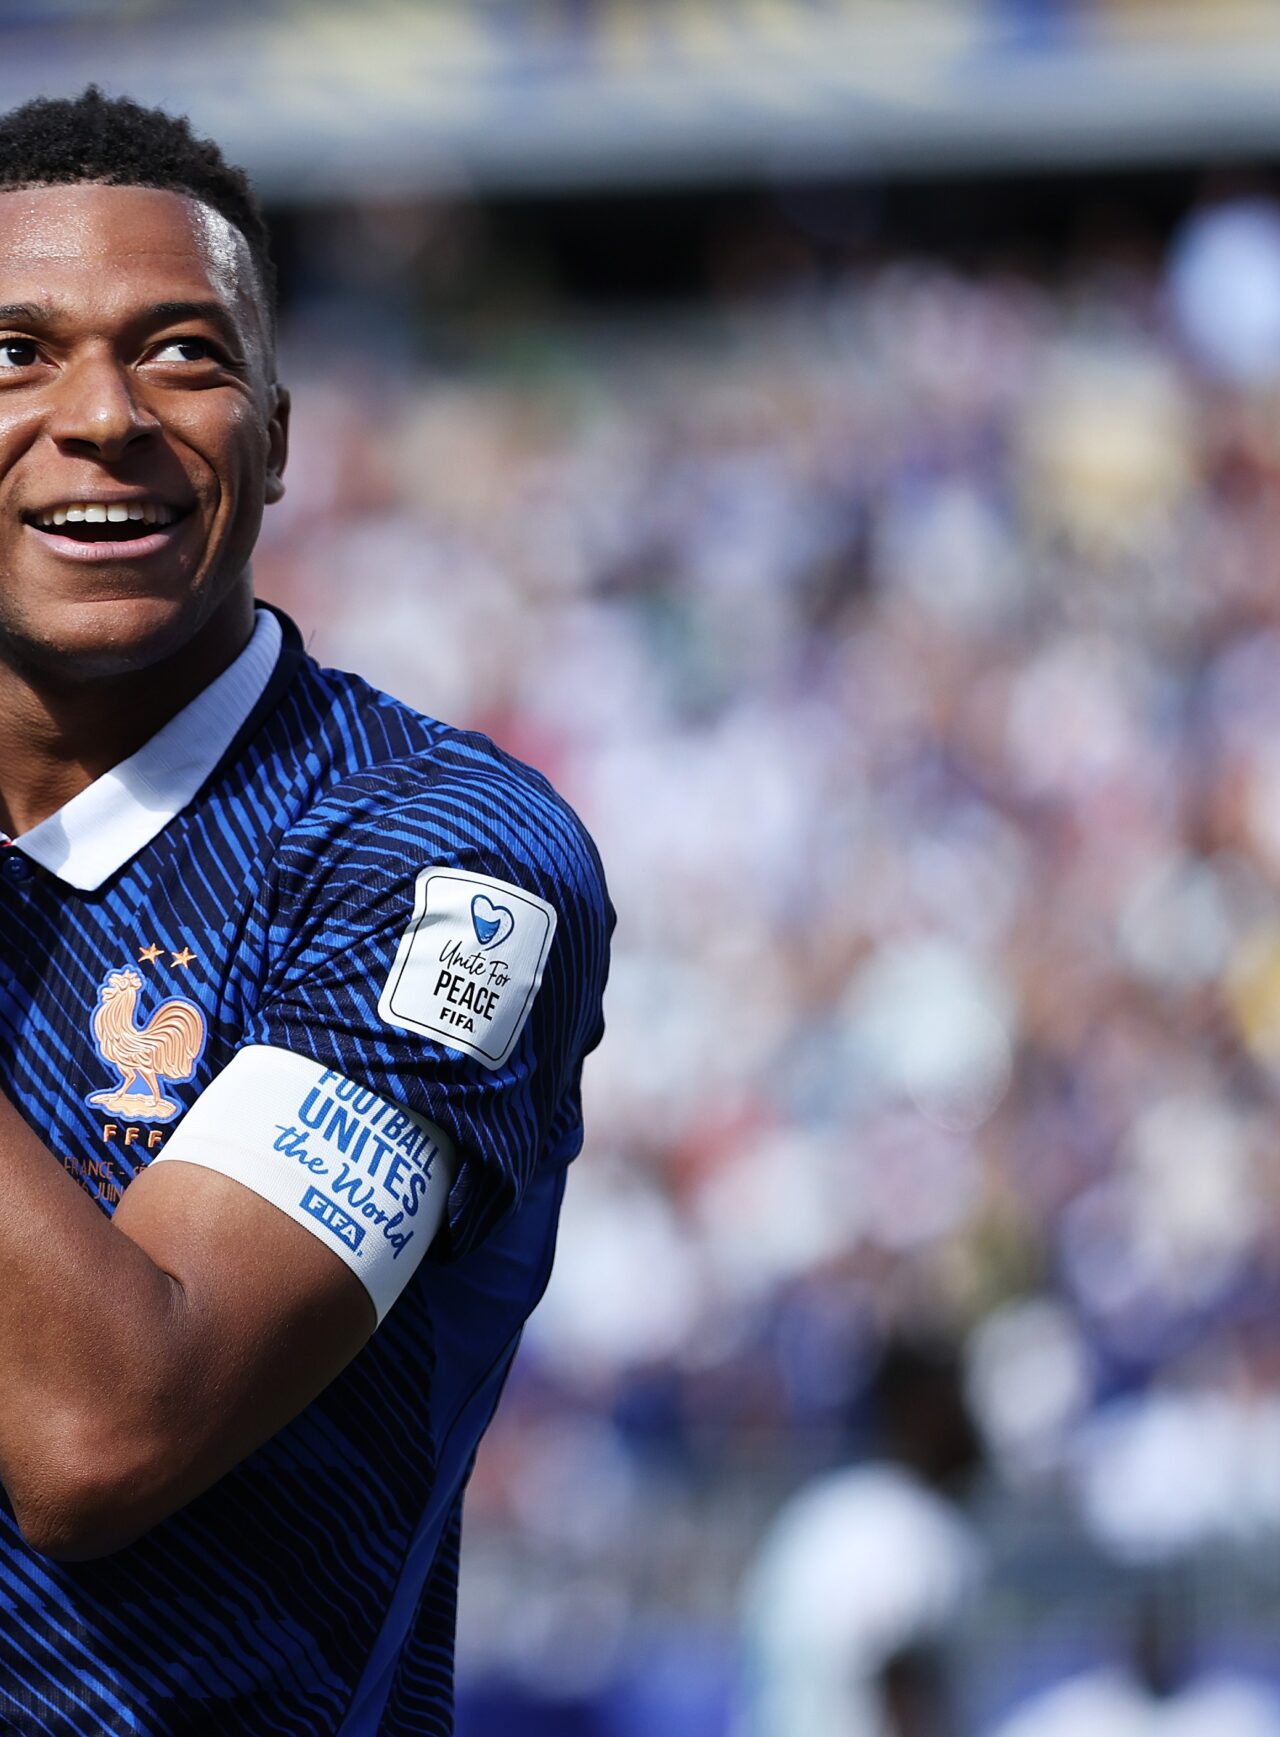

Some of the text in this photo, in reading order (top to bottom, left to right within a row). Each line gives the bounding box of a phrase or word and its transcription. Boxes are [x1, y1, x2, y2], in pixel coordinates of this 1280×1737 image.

[439, 940, 511, 987] Unite For
[433, 969, 500, 1021] PEACE
[439, 1007, 474, 1033] FIFA
[318, 1069, 439, 1180] FOOTBALL
[64, 1156, 114, 1179] FRANCE
[298, 1087, 426, 1217] UNITES
[273, 1125, 414, 1260] the World
[305, 1192, 360, 1247] FIFA
